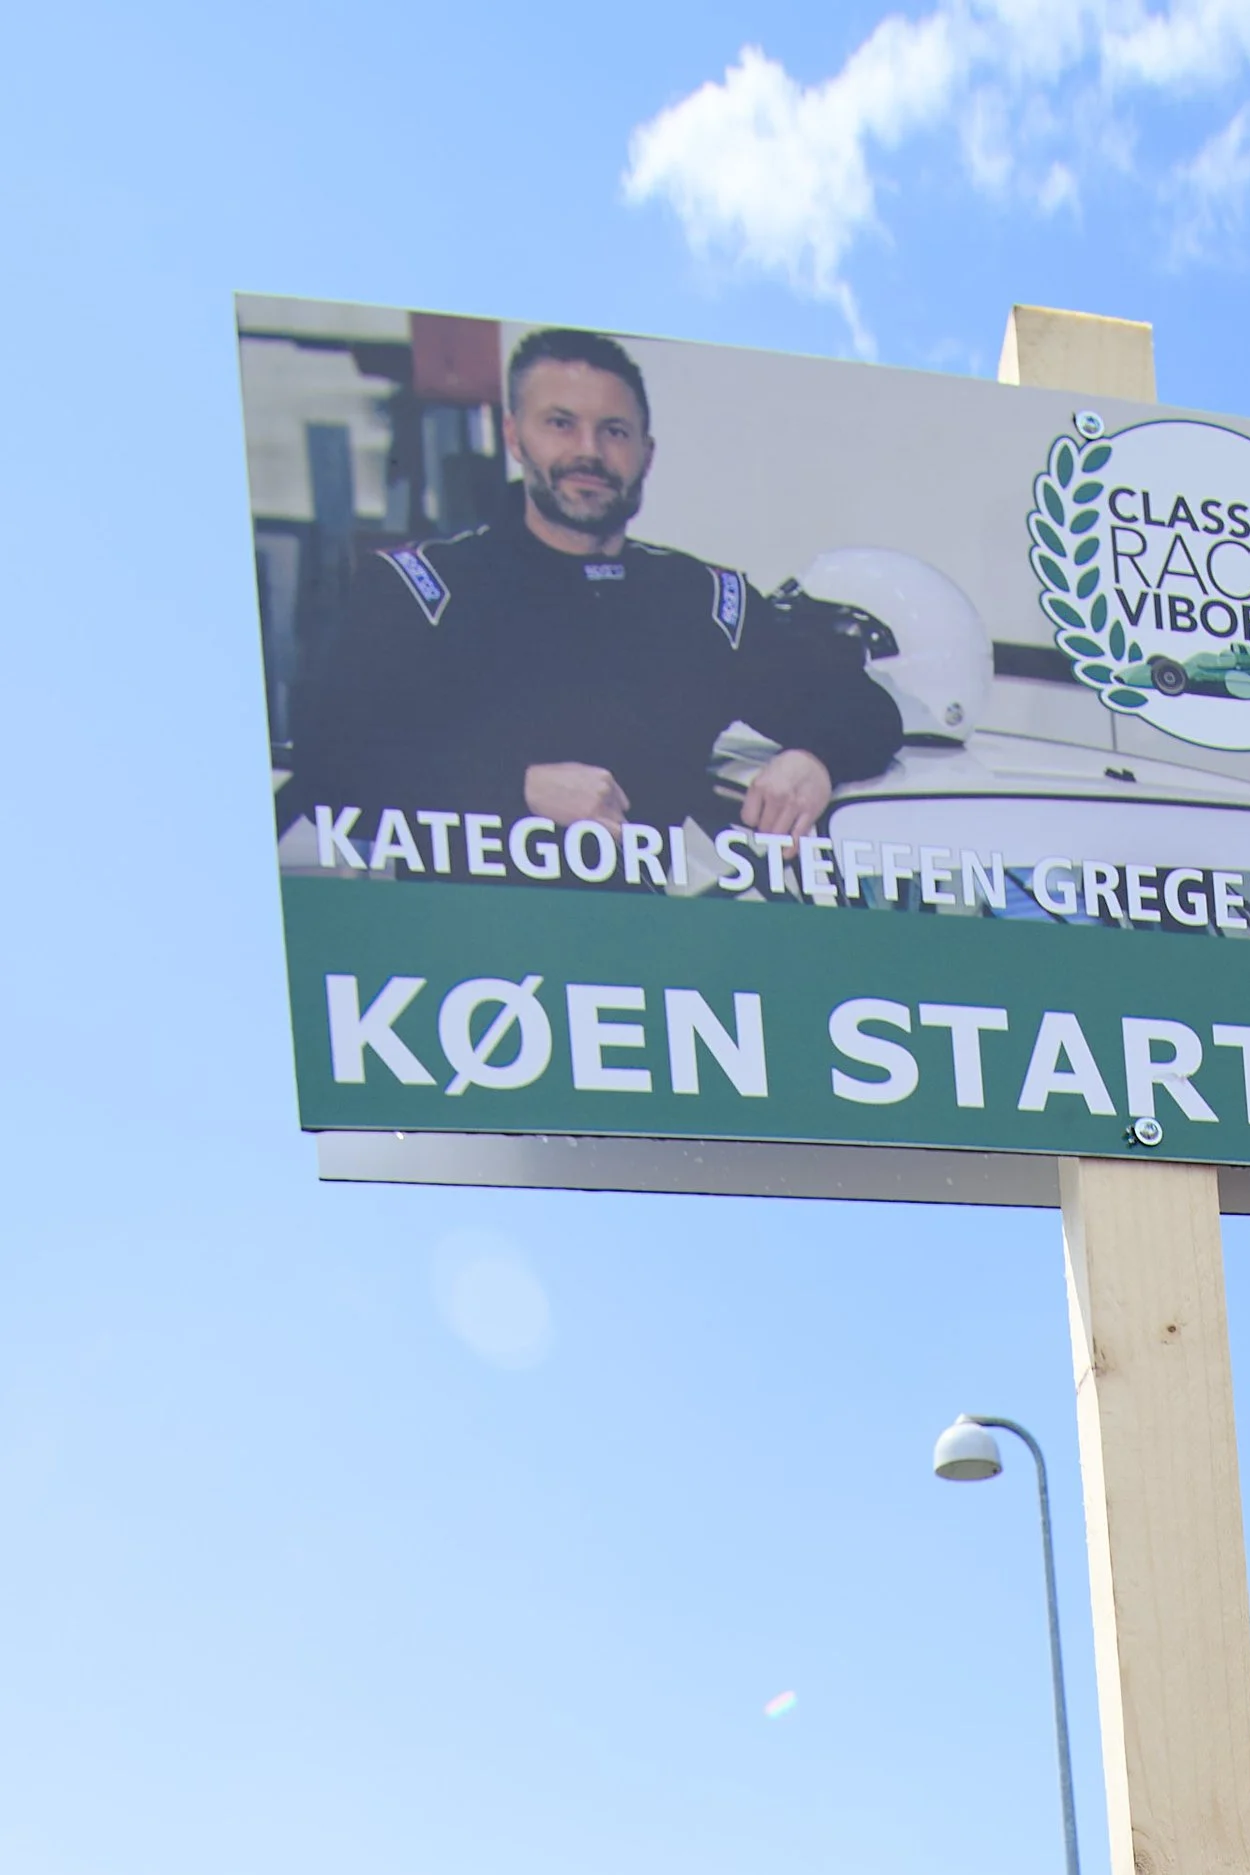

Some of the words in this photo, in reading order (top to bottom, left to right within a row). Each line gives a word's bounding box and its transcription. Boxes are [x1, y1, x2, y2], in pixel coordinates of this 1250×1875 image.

[314, 804, 688, 886] KATEGORI
[715, 831, 1007, 910] STEFFEN
[325, 973, 769, 1098] KØEN
